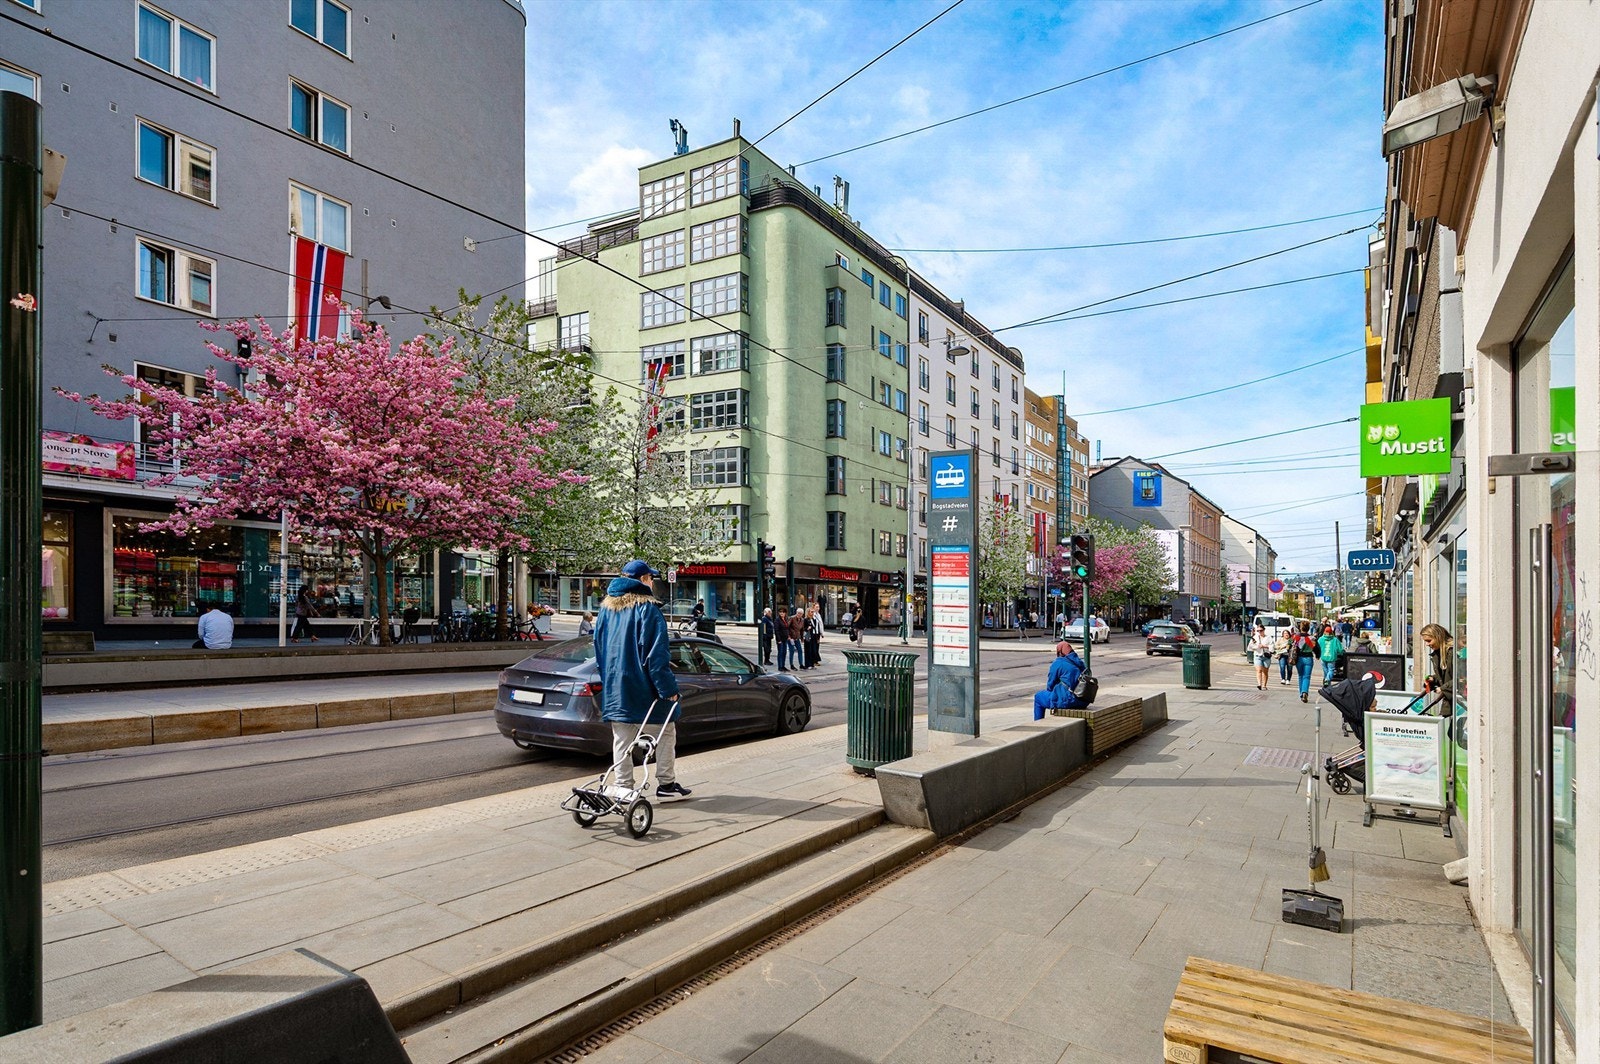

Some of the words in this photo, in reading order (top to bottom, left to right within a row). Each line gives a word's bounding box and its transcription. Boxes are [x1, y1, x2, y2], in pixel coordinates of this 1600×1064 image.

[44, 441, 81, 455] oncept
[83, 447, 110, 459] Store
[1380, 436, 1446, 455] Musti
[931, 502, 969, 511] Bogstadveien
[1352, 553, 1391, 566] norli
[820, 566, 859, 581] Dressmann
[1395, 727, 1427, 736] Potefin!
